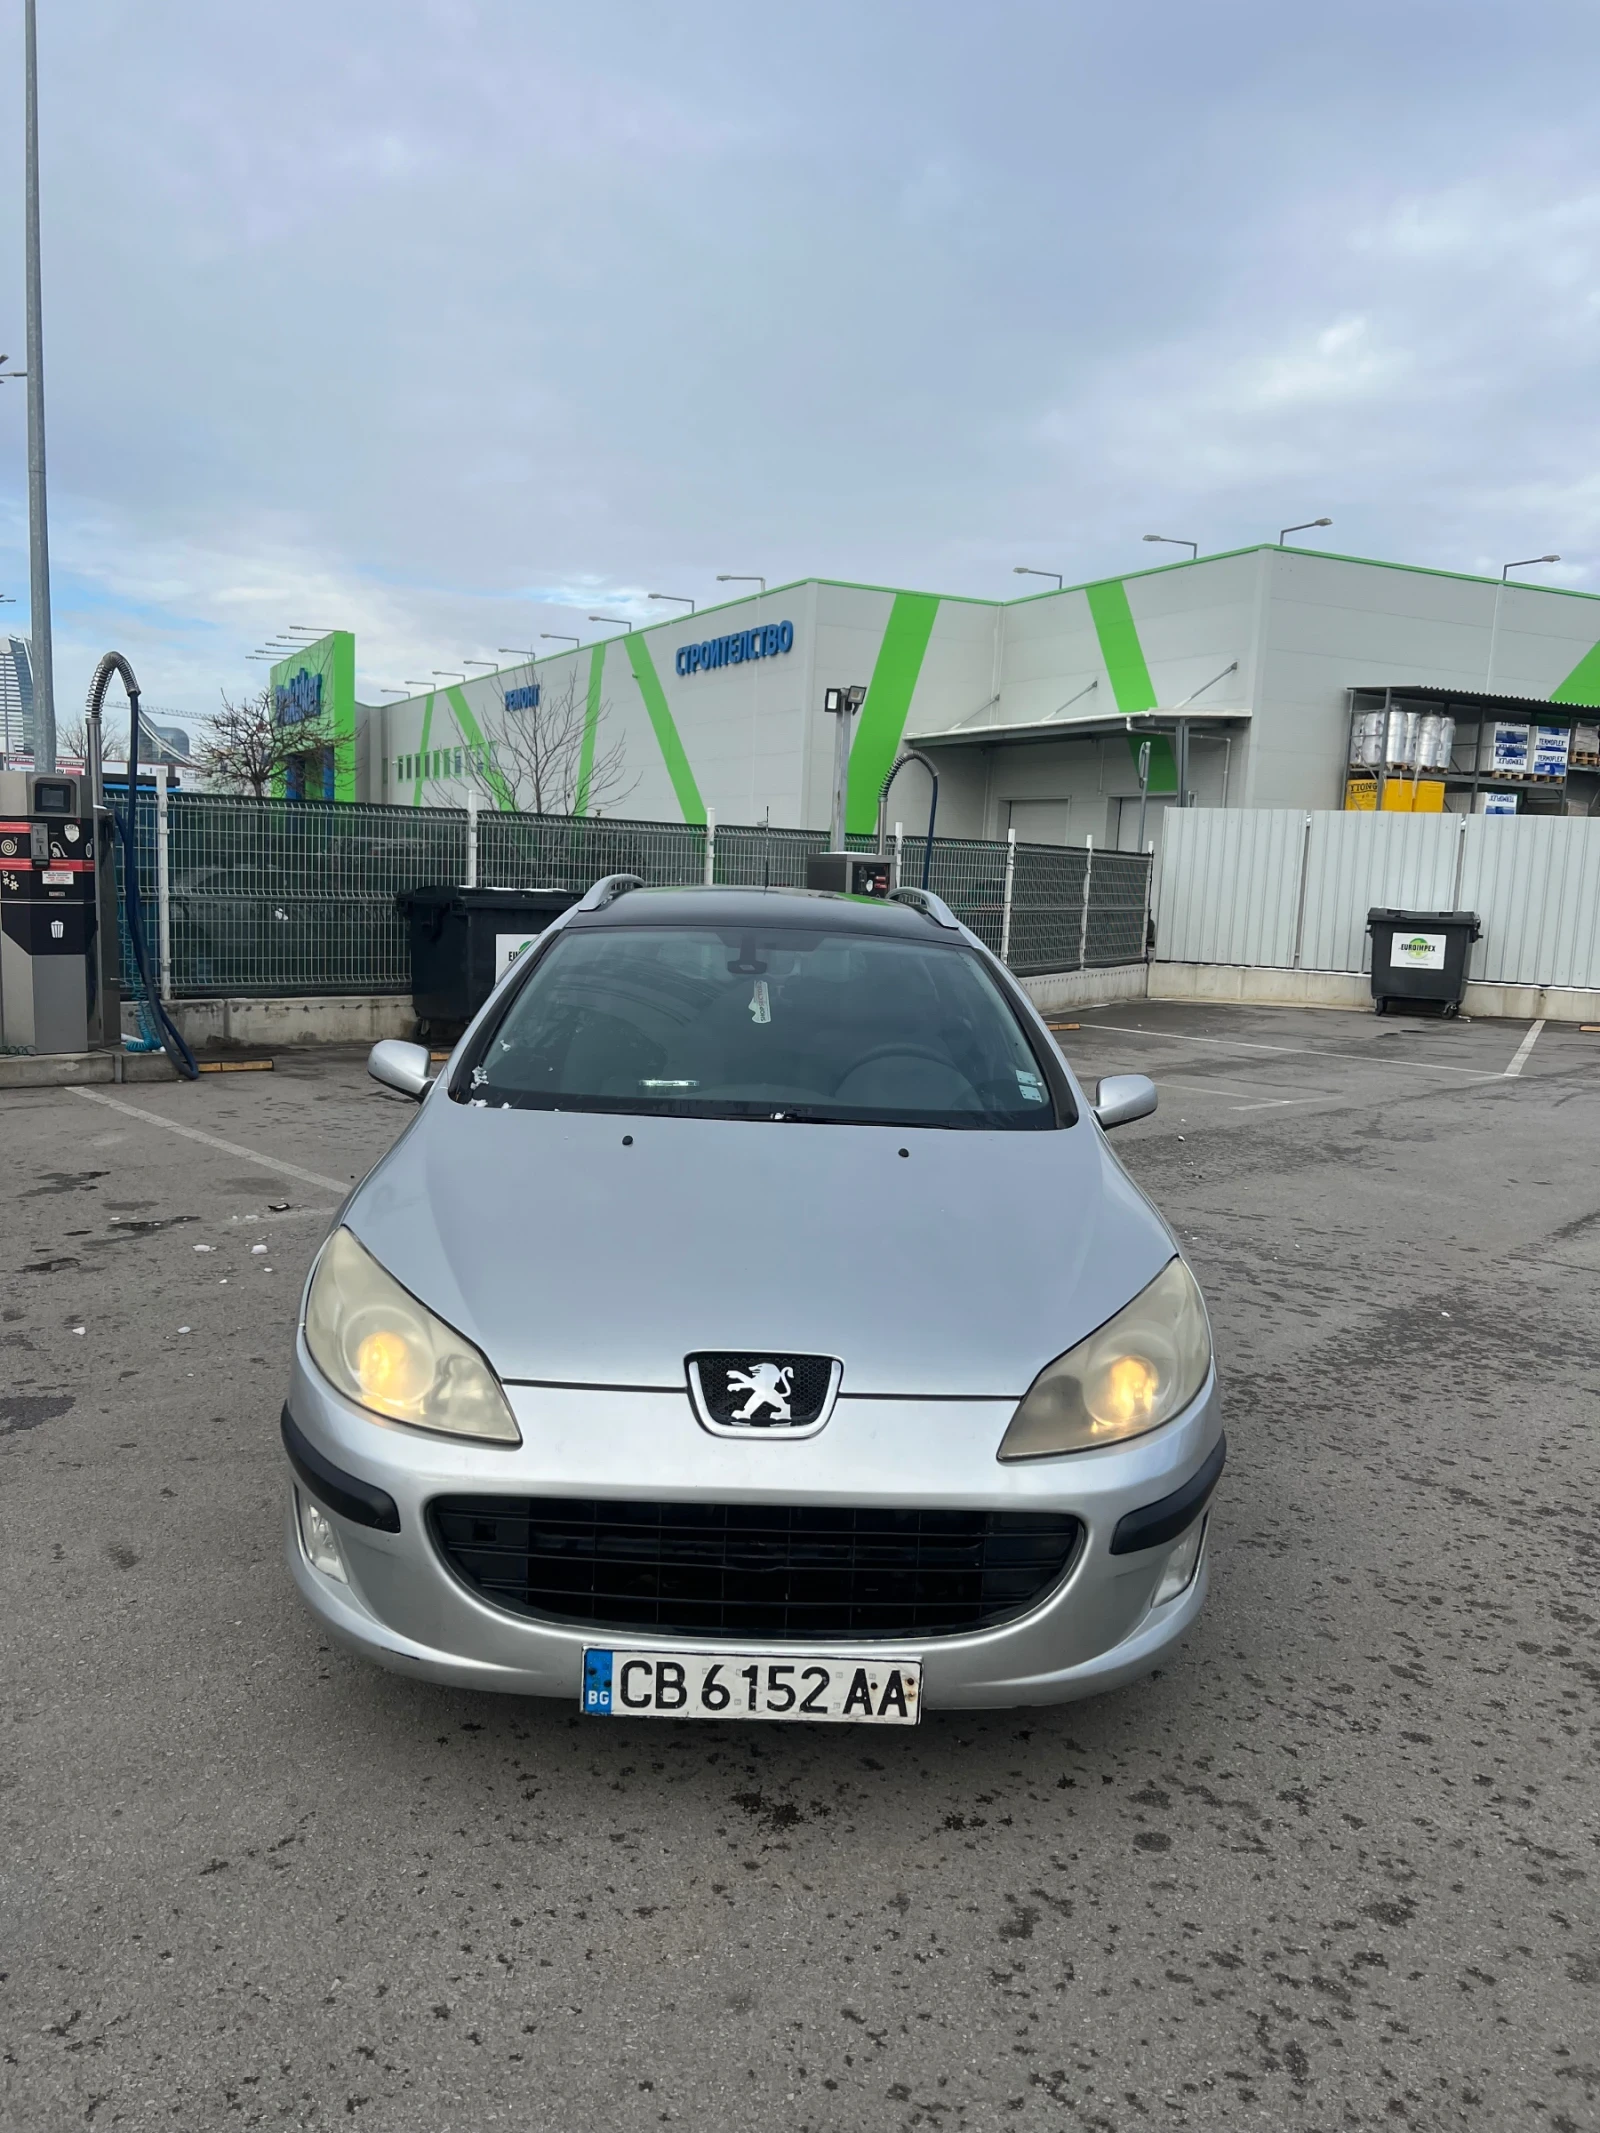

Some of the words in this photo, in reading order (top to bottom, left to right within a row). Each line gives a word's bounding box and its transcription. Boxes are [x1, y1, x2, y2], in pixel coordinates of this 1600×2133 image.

[676, 620, 793, 676] СТРОИТЕЛСТВО
[505, 684, 540, 711] РЕМОНТ
[1350, 783, 1378, 792] YTONG
[1400, 944, 1436, 952] EUROIMPEX
[588, 1690, 610, 1705] BG
[620, 1660, 688, 1709] CB
[701, 1664, 829, 1713] 6152
[842, 1668, 908, 1717] AA
